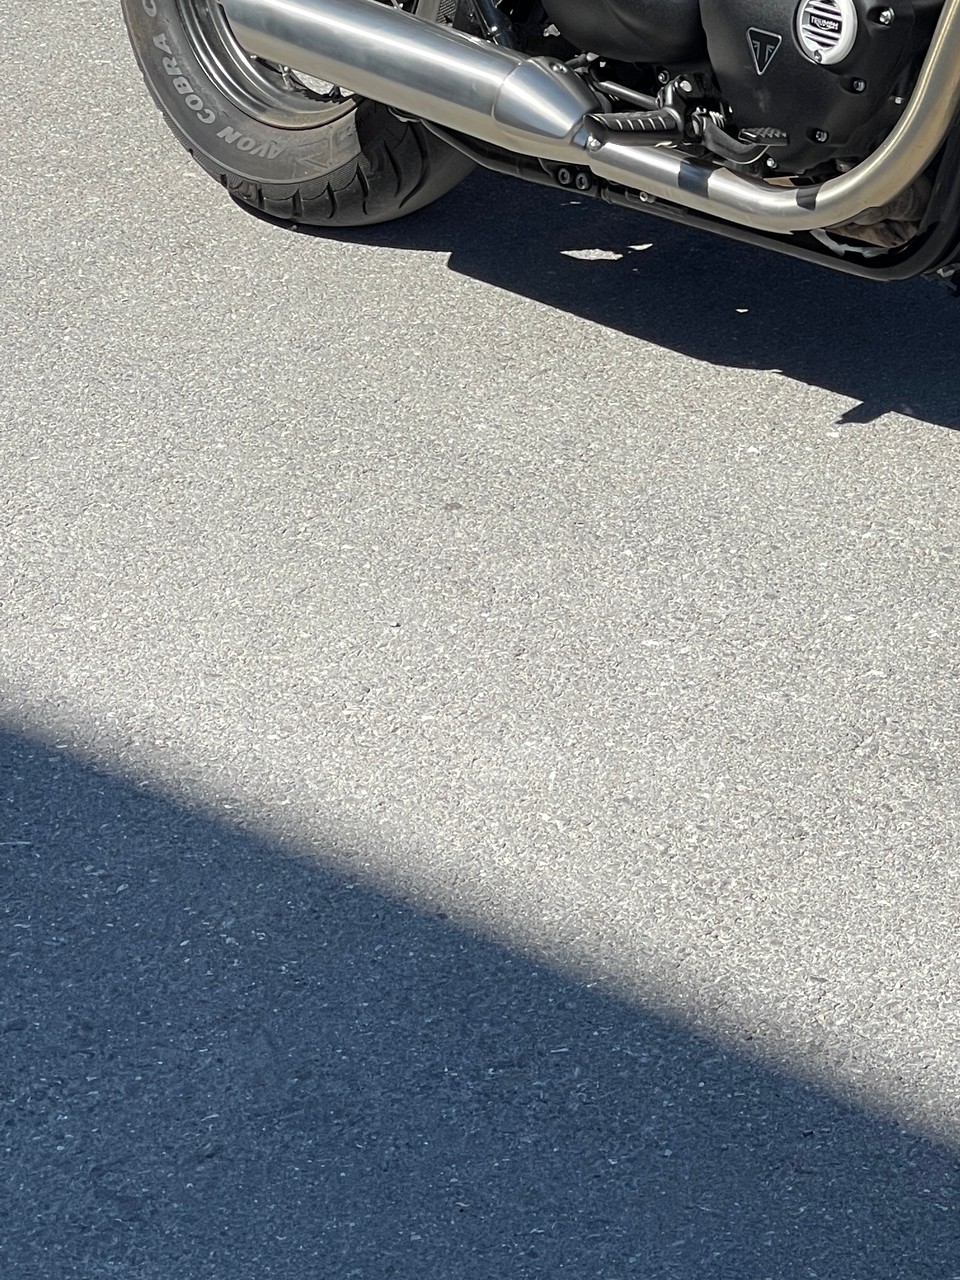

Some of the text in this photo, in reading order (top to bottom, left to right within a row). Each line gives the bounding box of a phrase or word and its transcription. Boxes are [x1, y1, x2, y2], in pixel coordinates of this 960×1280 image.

[810, 15, 839, 31] TRIUMPH
[153, 33, 287, 159] AVON COBRA
